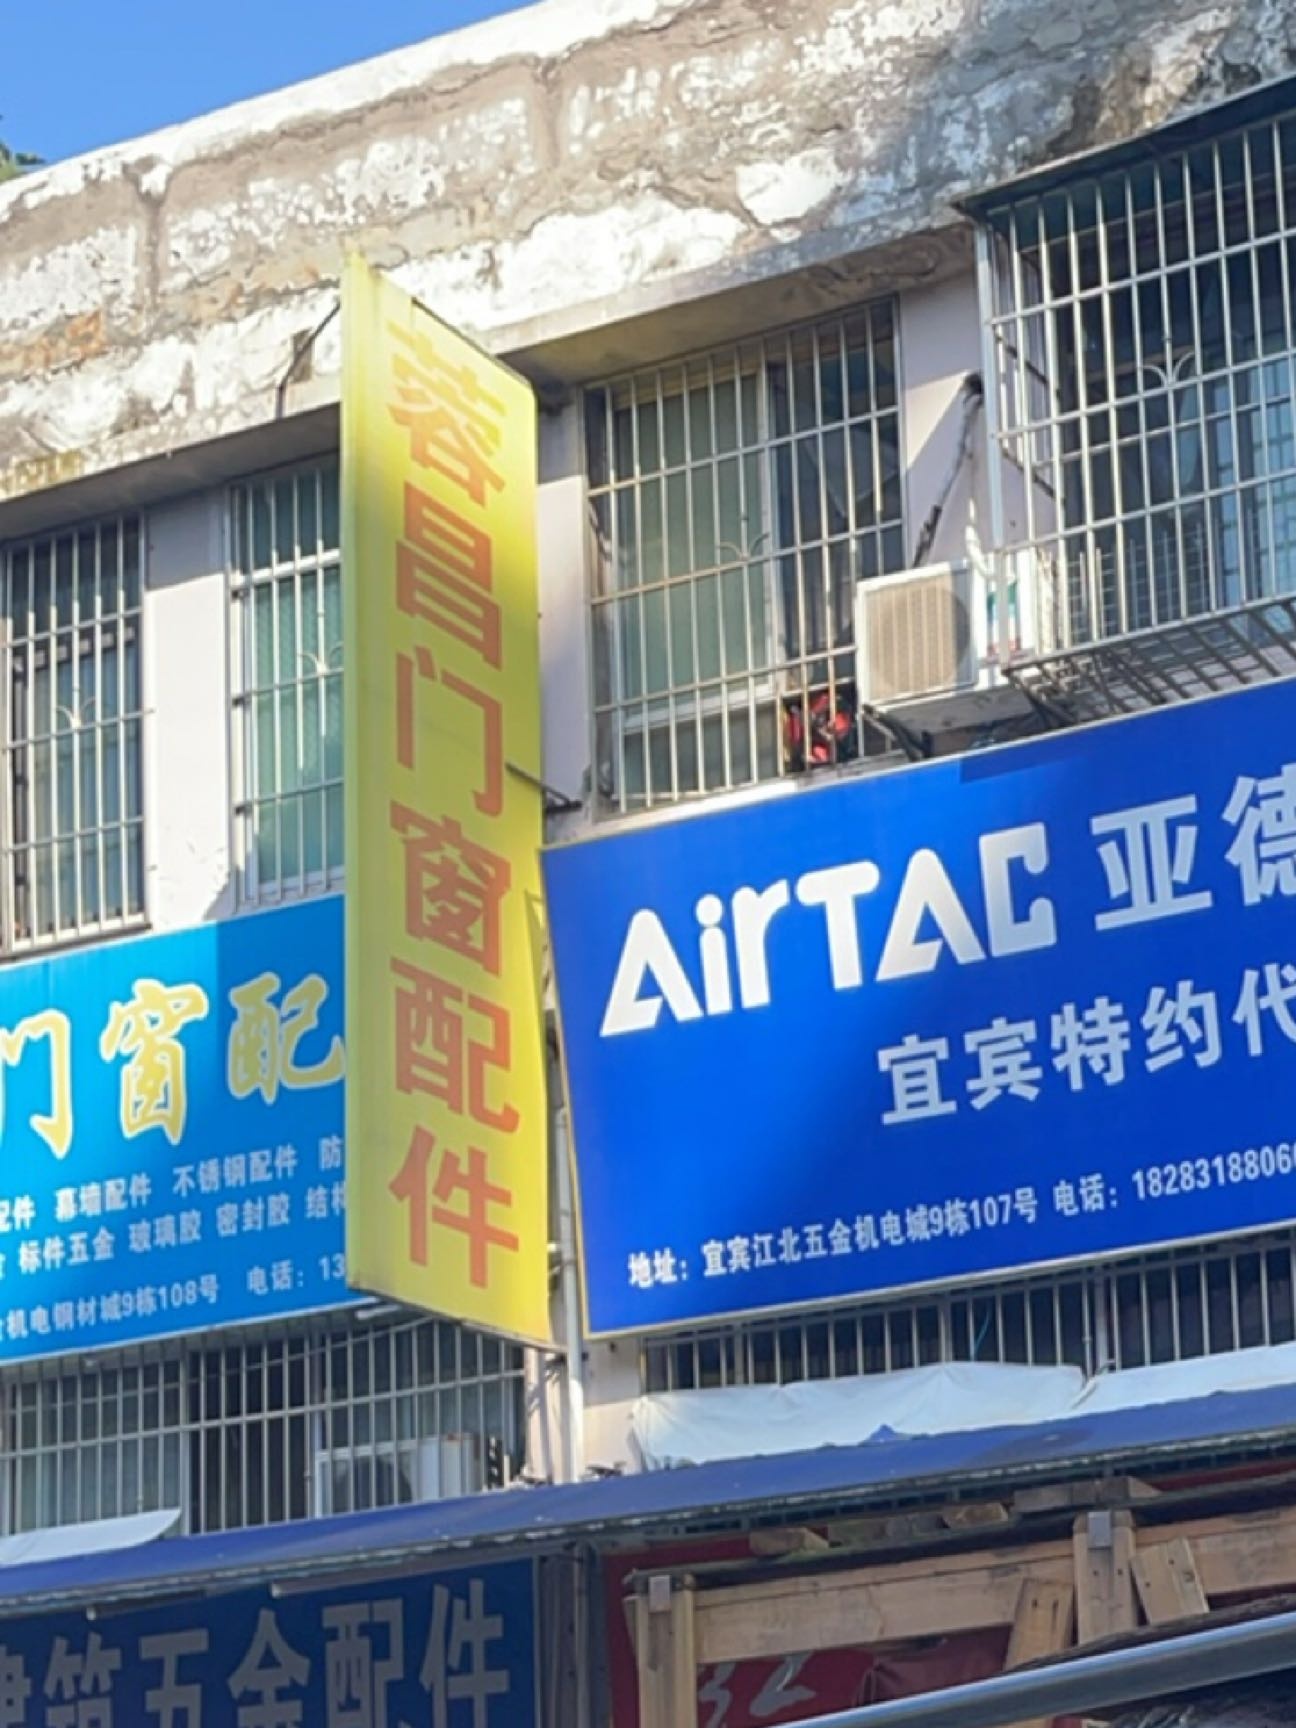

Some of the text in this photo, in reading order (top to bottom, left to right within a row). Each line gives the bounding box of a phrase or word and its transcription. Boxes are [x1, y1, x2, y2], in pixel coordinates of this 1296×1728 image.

[55, 1173, 151, 1222] 幕墙配件
[173, 1144, 297, 1197] 不锈钢配件
[129, 1209, 201, 1252] 玻璃胶
[216, 1193, 290, 1238] 密封胶
